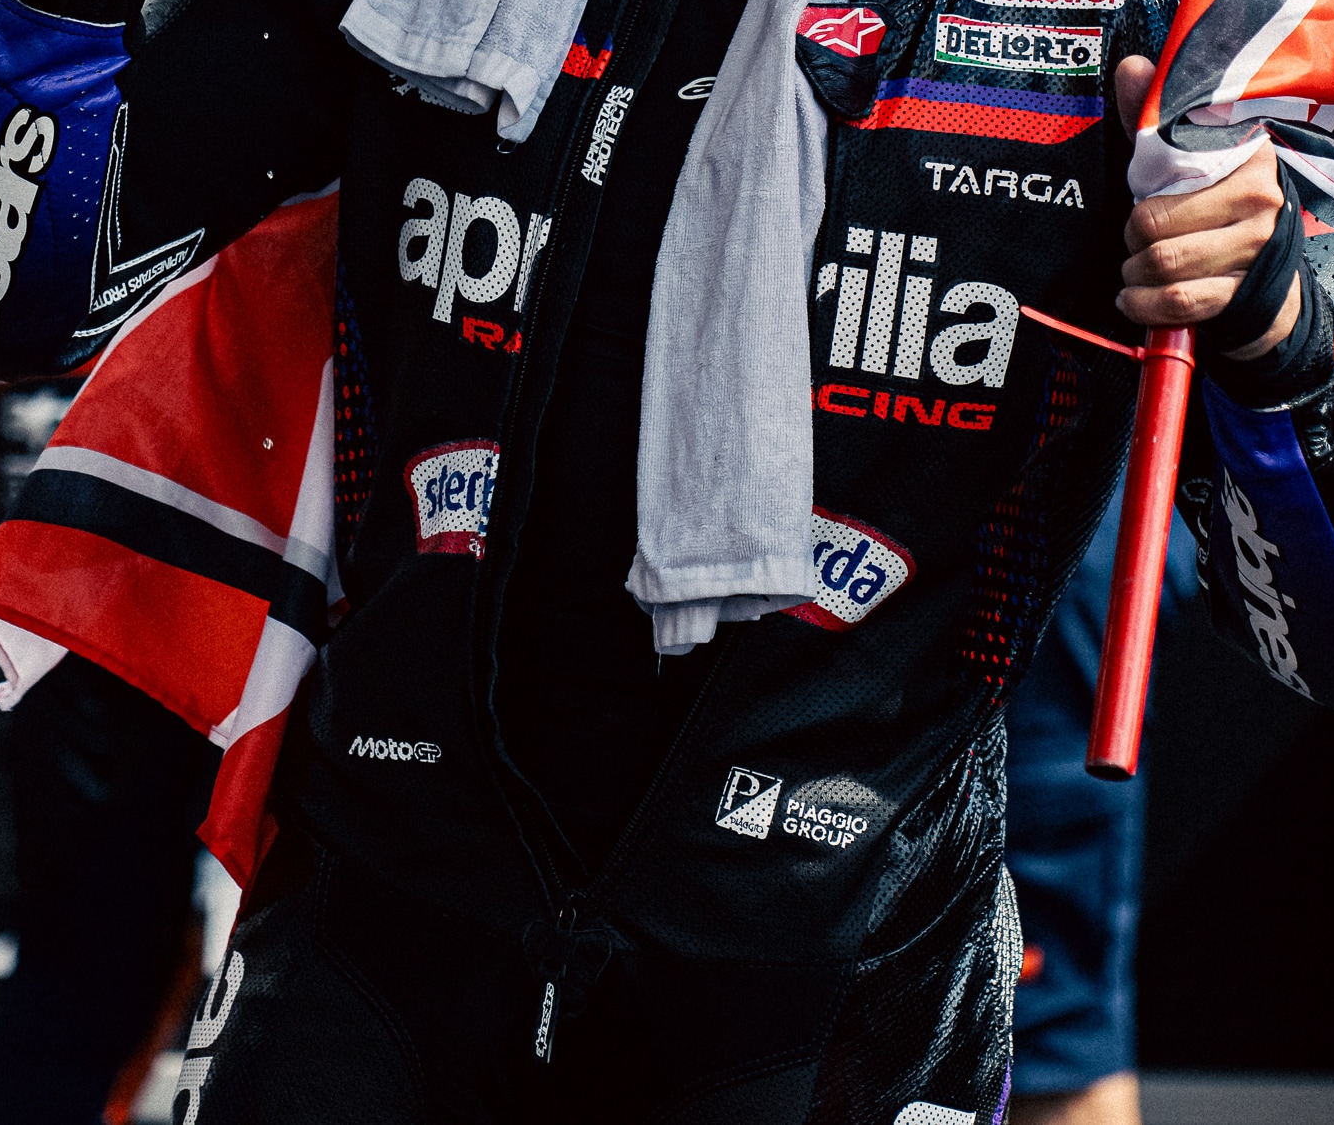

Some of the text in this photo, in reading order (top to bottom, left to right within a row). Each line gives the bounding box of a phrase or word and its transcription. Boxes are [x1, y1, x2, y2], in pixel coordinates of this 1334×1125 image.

[945, 25, 1092, 66] DELLORTO
[580, 85, 625, 182] ALPINESTARS
[590, 87, 635, 187] PROTECTS
[925, 161, 1084, 209] TARGA
[127, 246, 190, 294] ALPINESTARS
[811, 383, 997, 431] CING
[782, 818, 855, 849] GROUP
[786, 799, 868, 834] PIAGGIO
